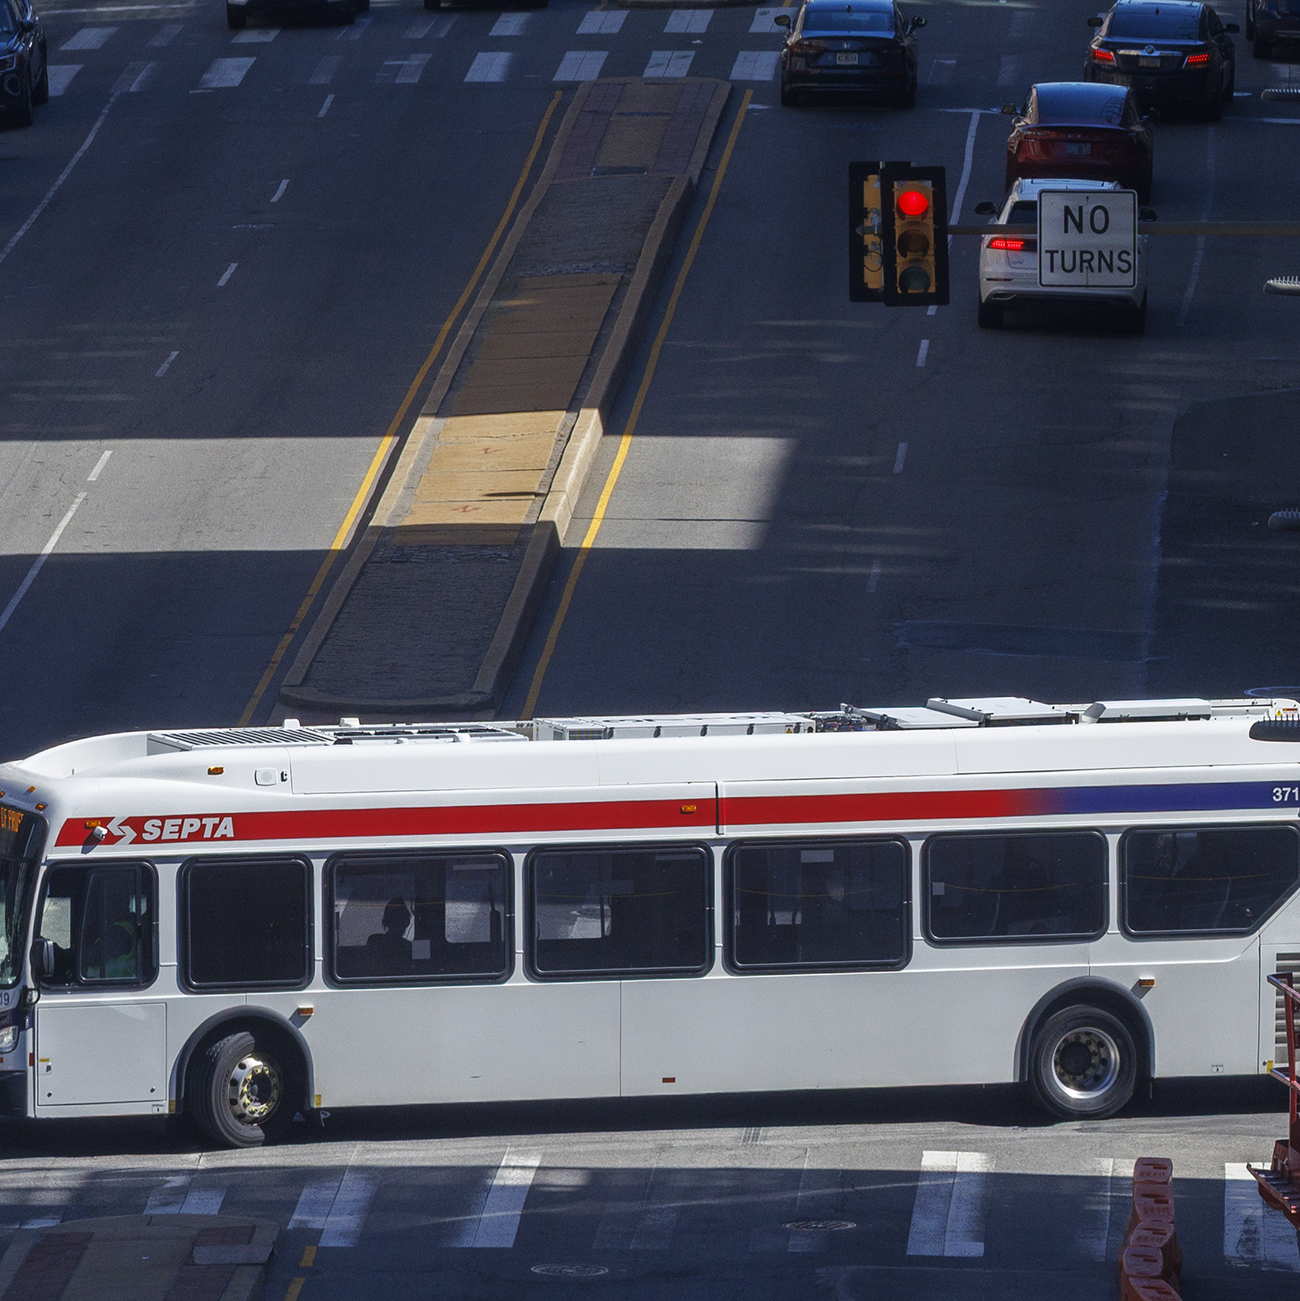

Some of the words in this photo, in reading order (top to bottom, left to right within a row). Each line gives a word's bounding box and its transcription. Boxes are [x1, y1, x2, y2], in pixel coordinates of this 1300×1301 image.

[1062, 205, 1111, 235] NO
[1045, 249, 1132, 276] TURNS
[141, 816, 235, 841] SEPTA
